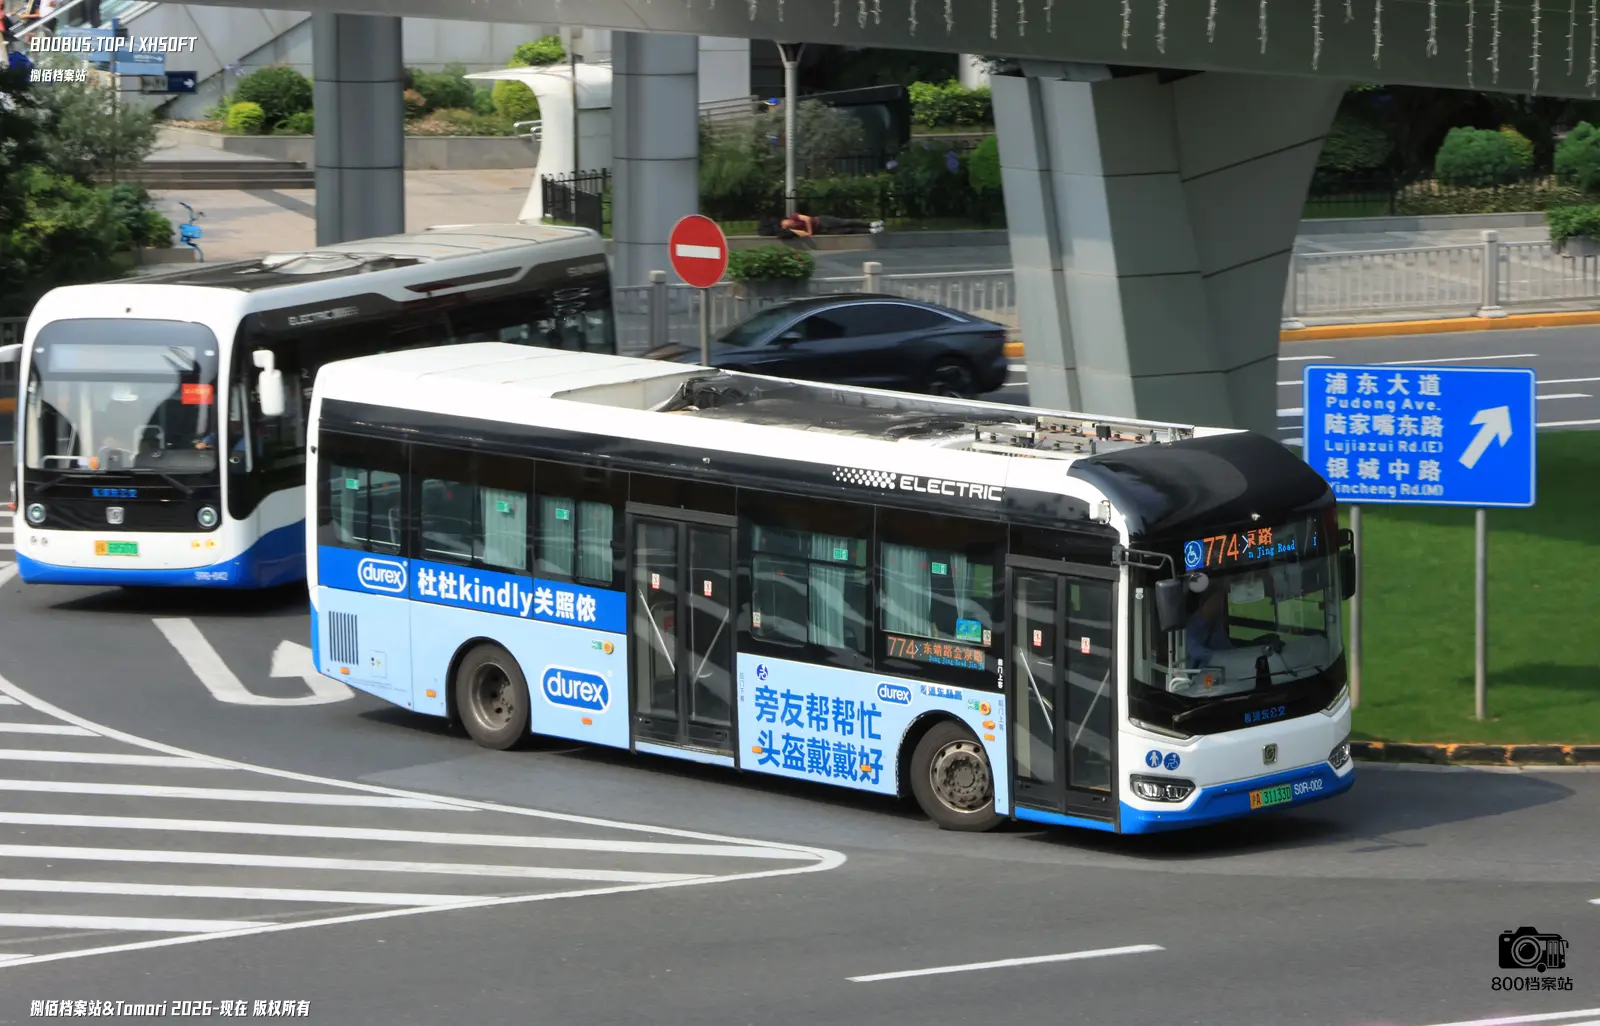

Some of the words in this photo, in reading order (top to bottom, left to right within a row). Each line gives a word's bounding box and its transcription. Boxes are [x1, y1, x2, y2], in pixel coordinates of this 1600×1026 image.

[1324, 372, 1442, 396] 浦东大道
[1325, 396, 1396, 412] Pudong
[1401, 398, 1441, 411] Ave.
[1324, 413, 1444, 437] 陆家嘴东路
[1324, 440, 1394, 455] Lujiazui
[1398, 441, 1444, 453] Rd.(E)
[1326, 457, 1442, 482] 银城中路
[899, 475, 1003, 501] ELECTRIC
[1203, 533, 1239, 567] 774
[1256, 545, 1275, 559] Jing
[1277, 540, 1296, 553] Road
[361, 566, 402, 588] durex
[417, 567, 597, 623] 杜杜kindly关照侬
[888, 636, 916, 659] 774
[547, 671, 607, 708] durex
[879, 685, 911, 702] durex
[754, 685, 883, 741] 旁友帮帮忙
[757, 730, 884, 785] 头盔戴戴好
